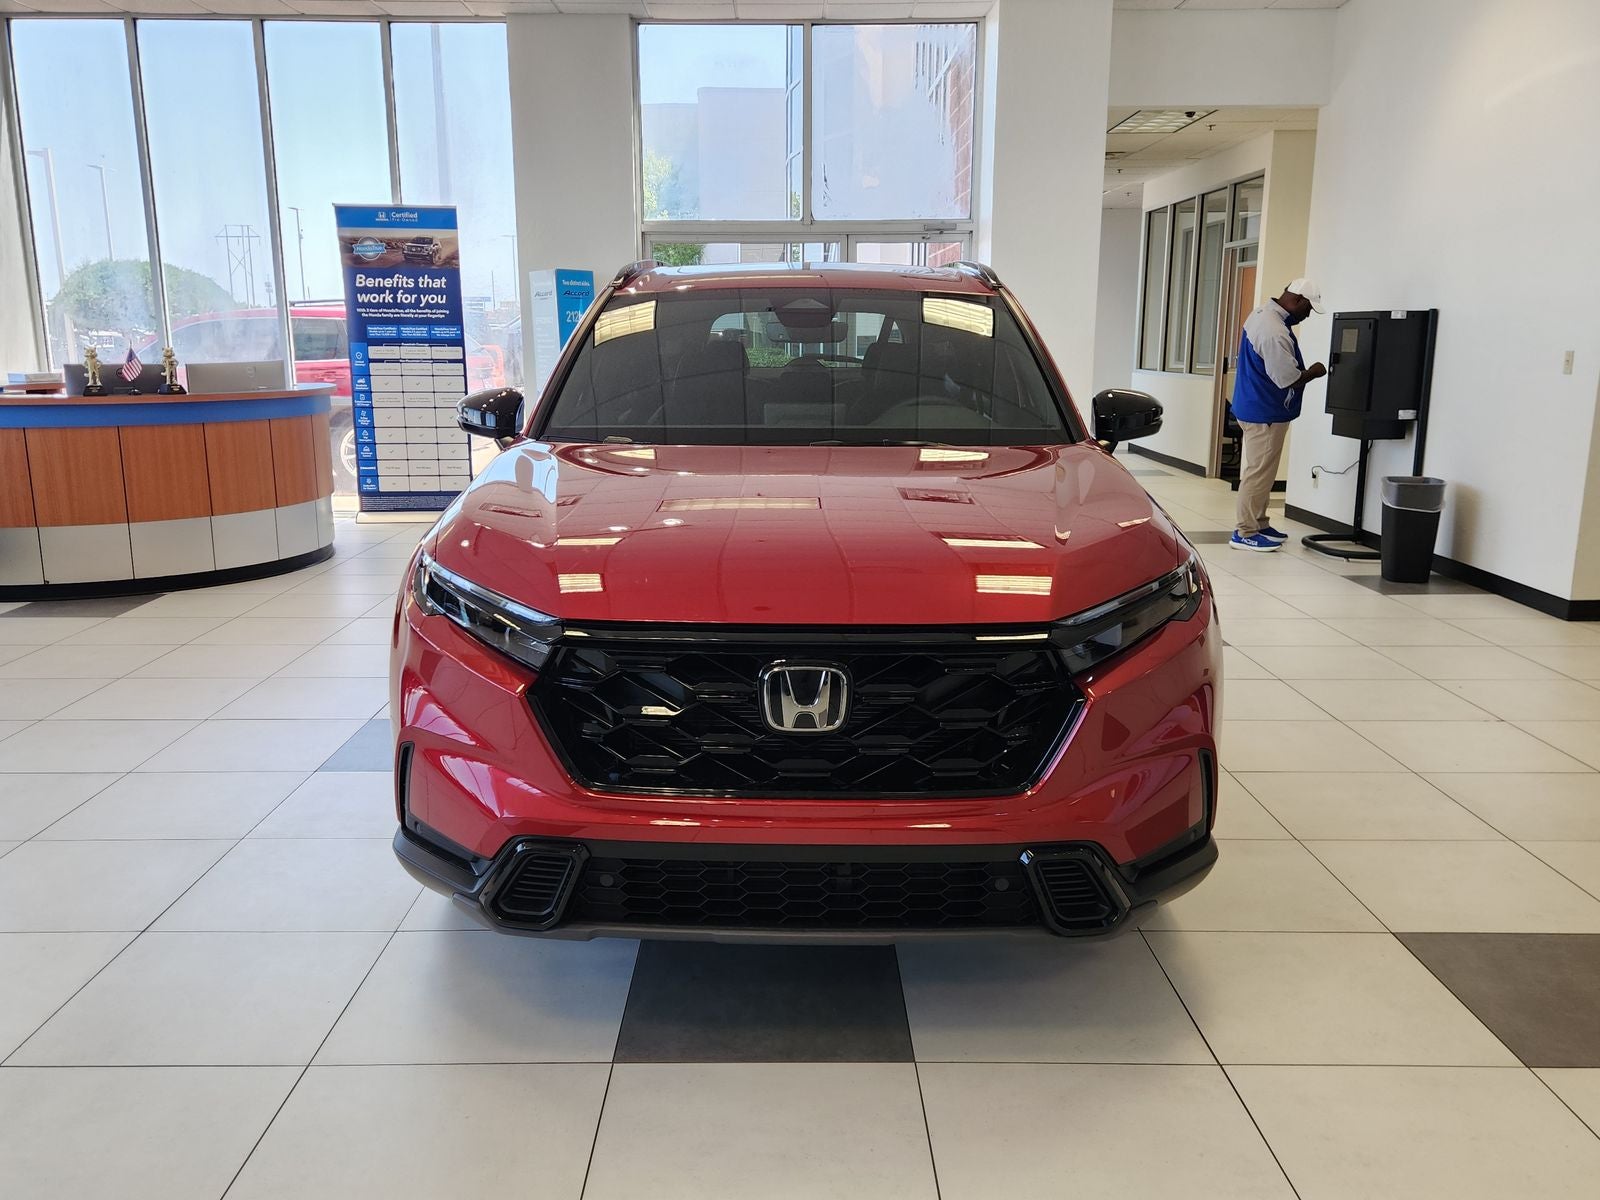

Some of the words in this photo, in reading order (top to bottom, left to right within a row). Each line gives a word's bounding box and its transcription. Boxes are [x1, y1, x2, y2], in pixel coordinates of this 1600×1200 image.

[355, 274, 415, 288] Benefits
[418, 274, 446, 288] that
[357, 290, 393, 303] work
[397, 290, 417, 303] for
[420, 294, 446, 307] you
